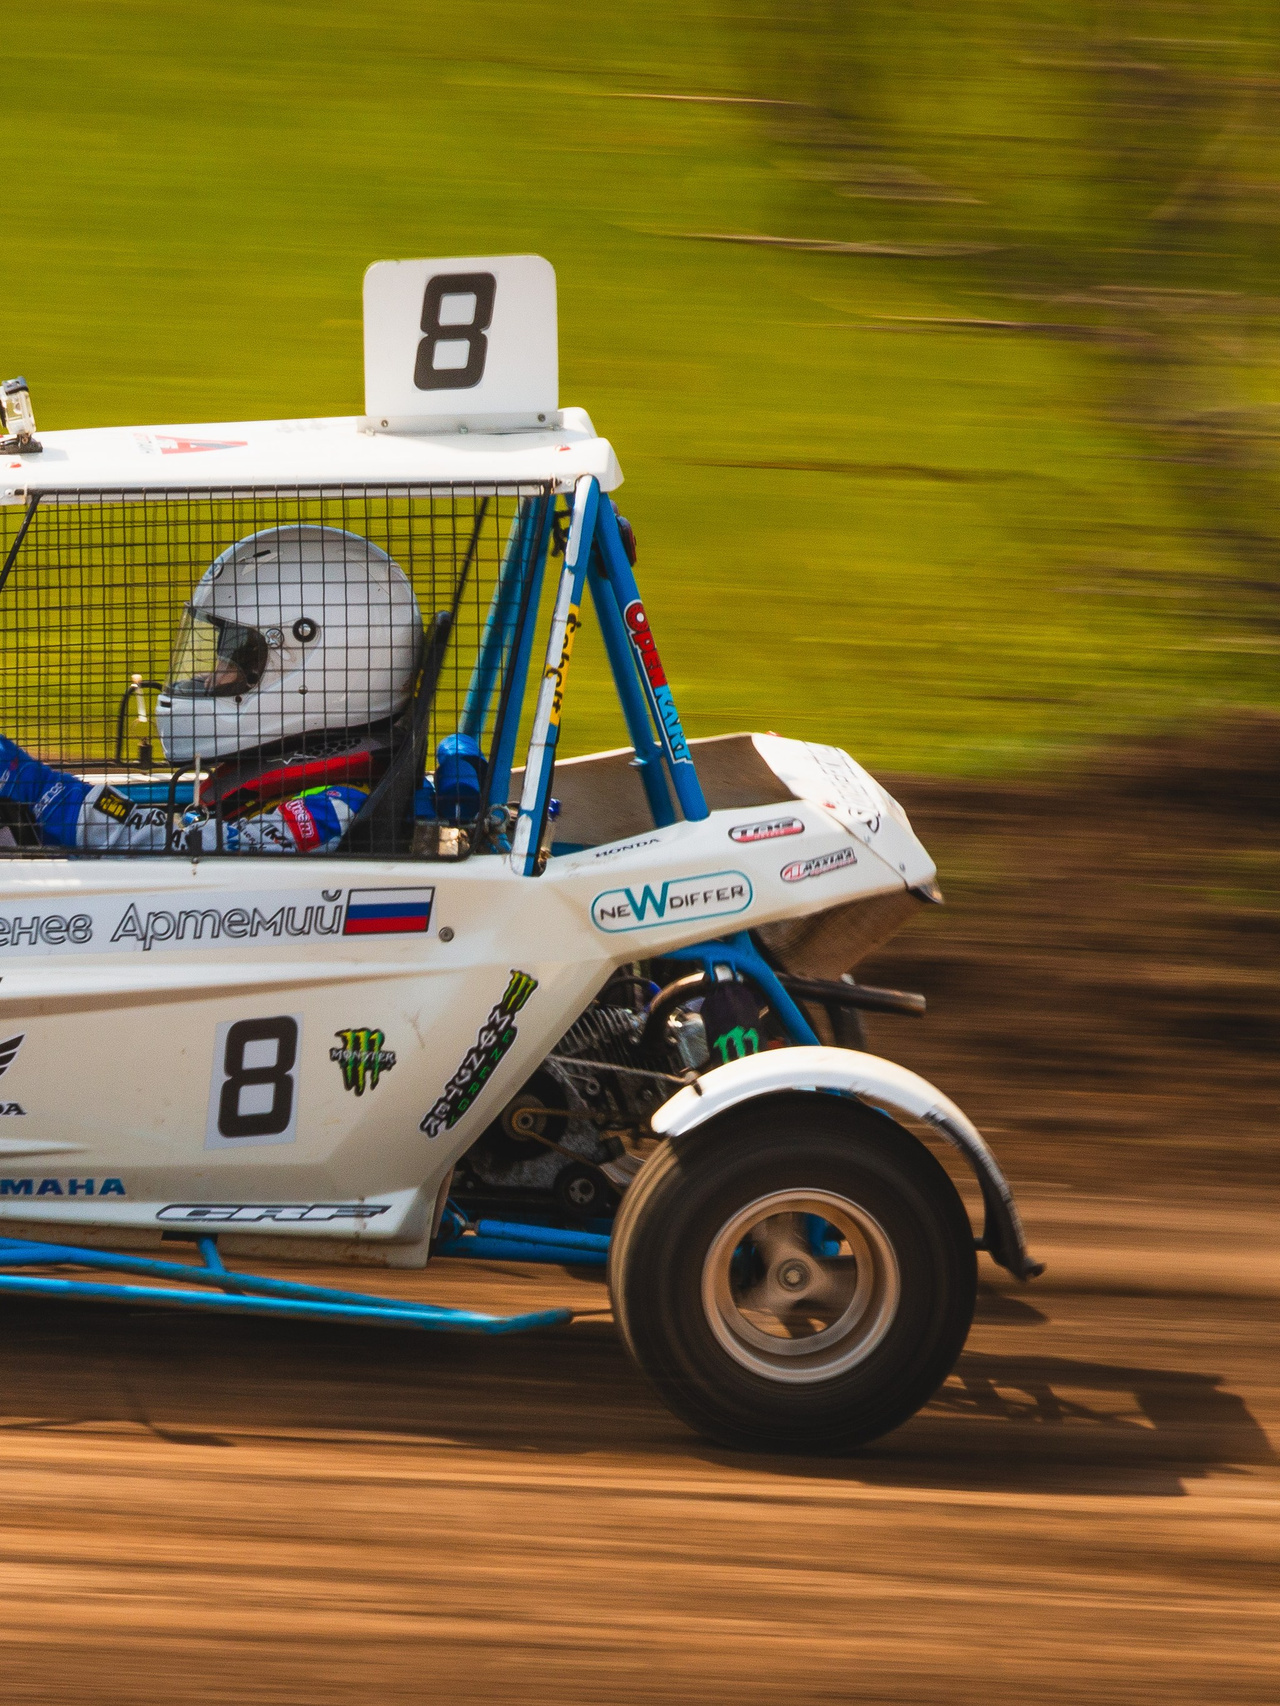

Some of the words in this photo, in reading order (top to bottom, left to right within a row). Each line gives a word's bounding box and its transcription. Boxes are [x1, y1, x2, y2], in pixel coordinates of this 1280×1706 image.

[413, 271, 497, 391] 8
[595, 838, 660, 857] HONDA
[110, 889, 342, 951] Артемий
[219, 1015, 298, 1138] 8
[423, 1008, 512, 1135] MONSTER
